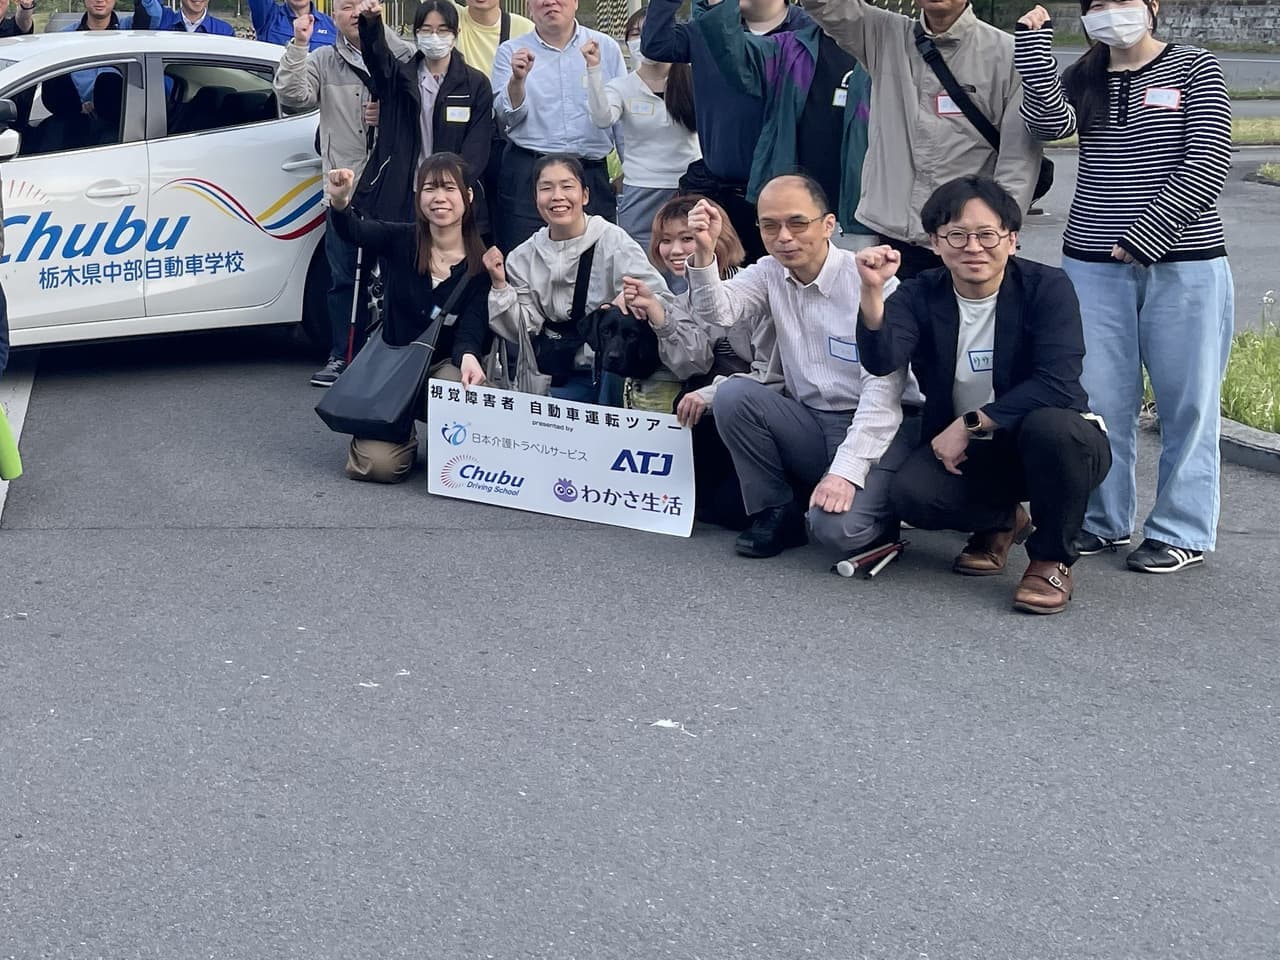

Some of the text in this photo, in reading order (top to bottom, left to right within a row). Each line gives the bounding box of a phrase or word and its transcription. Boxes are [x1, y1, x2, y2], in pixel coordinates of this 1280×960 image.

[39, 251, 246, 290] 栃木県中部自動車学校
[430, 384, 683, 431] 視覚障害者 自動車運転ツアー
[471, 432, 588, 462] 日本介護トラベルサービス
[459, 464, 525, 487] Chubu
[610, 449, 674, 476] ATJ
[466, 481, 520, 496] Driving School
[581, 486, 683, 516] わかさ生活
